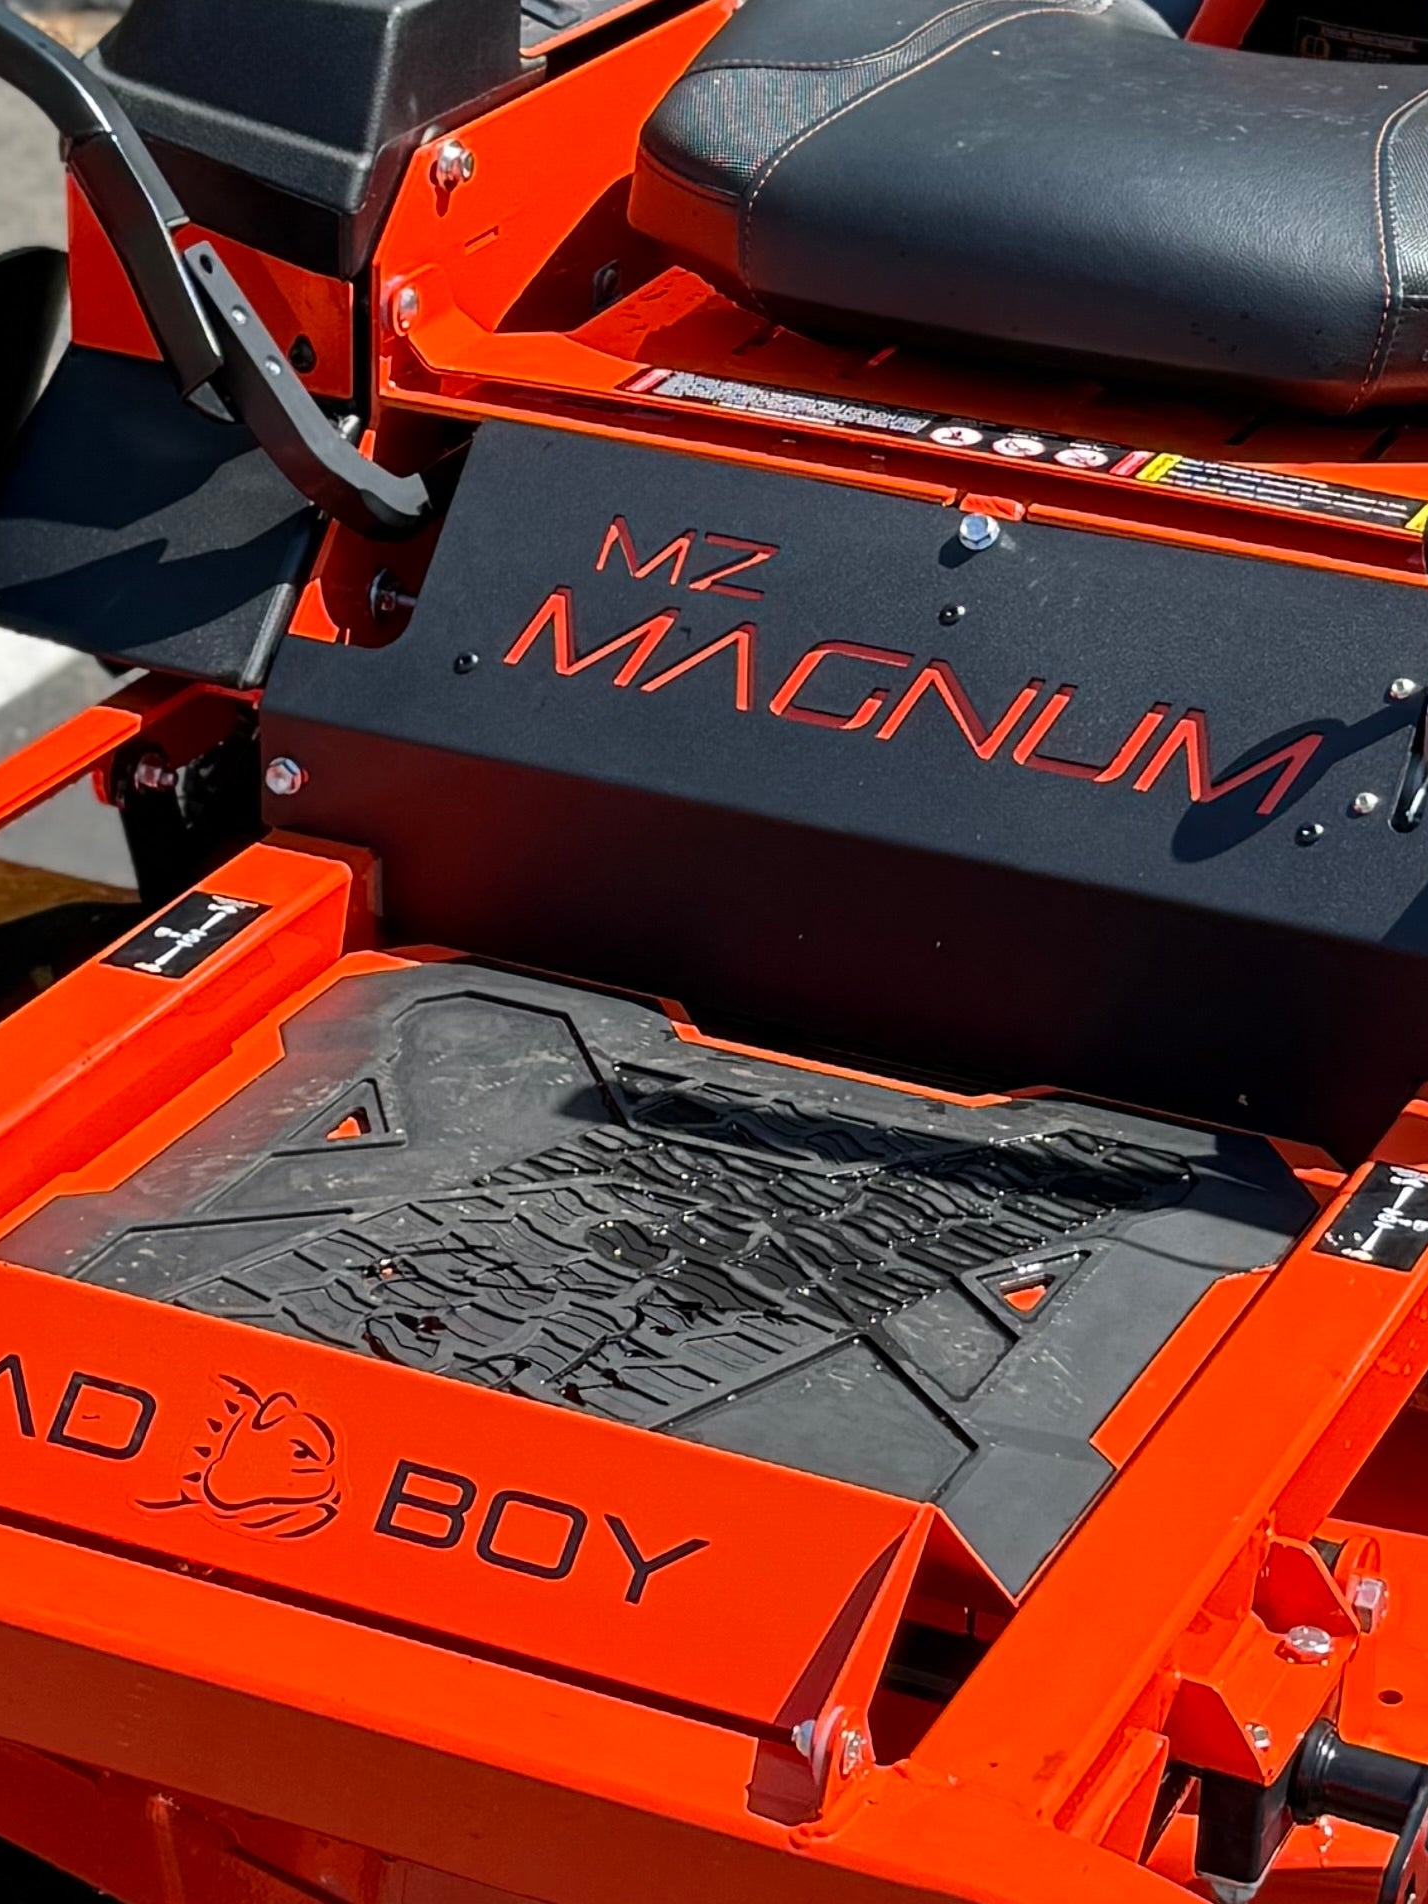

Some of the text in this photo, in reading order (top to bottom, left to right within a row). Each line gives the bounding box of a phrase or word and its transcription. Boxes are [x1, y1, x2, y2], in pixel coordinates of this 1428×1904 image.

[594, 515, 782, 602] MZ
[502, 584, 1325, 817] MAGNUM
[372, 1458, 712, 1606] BOY
